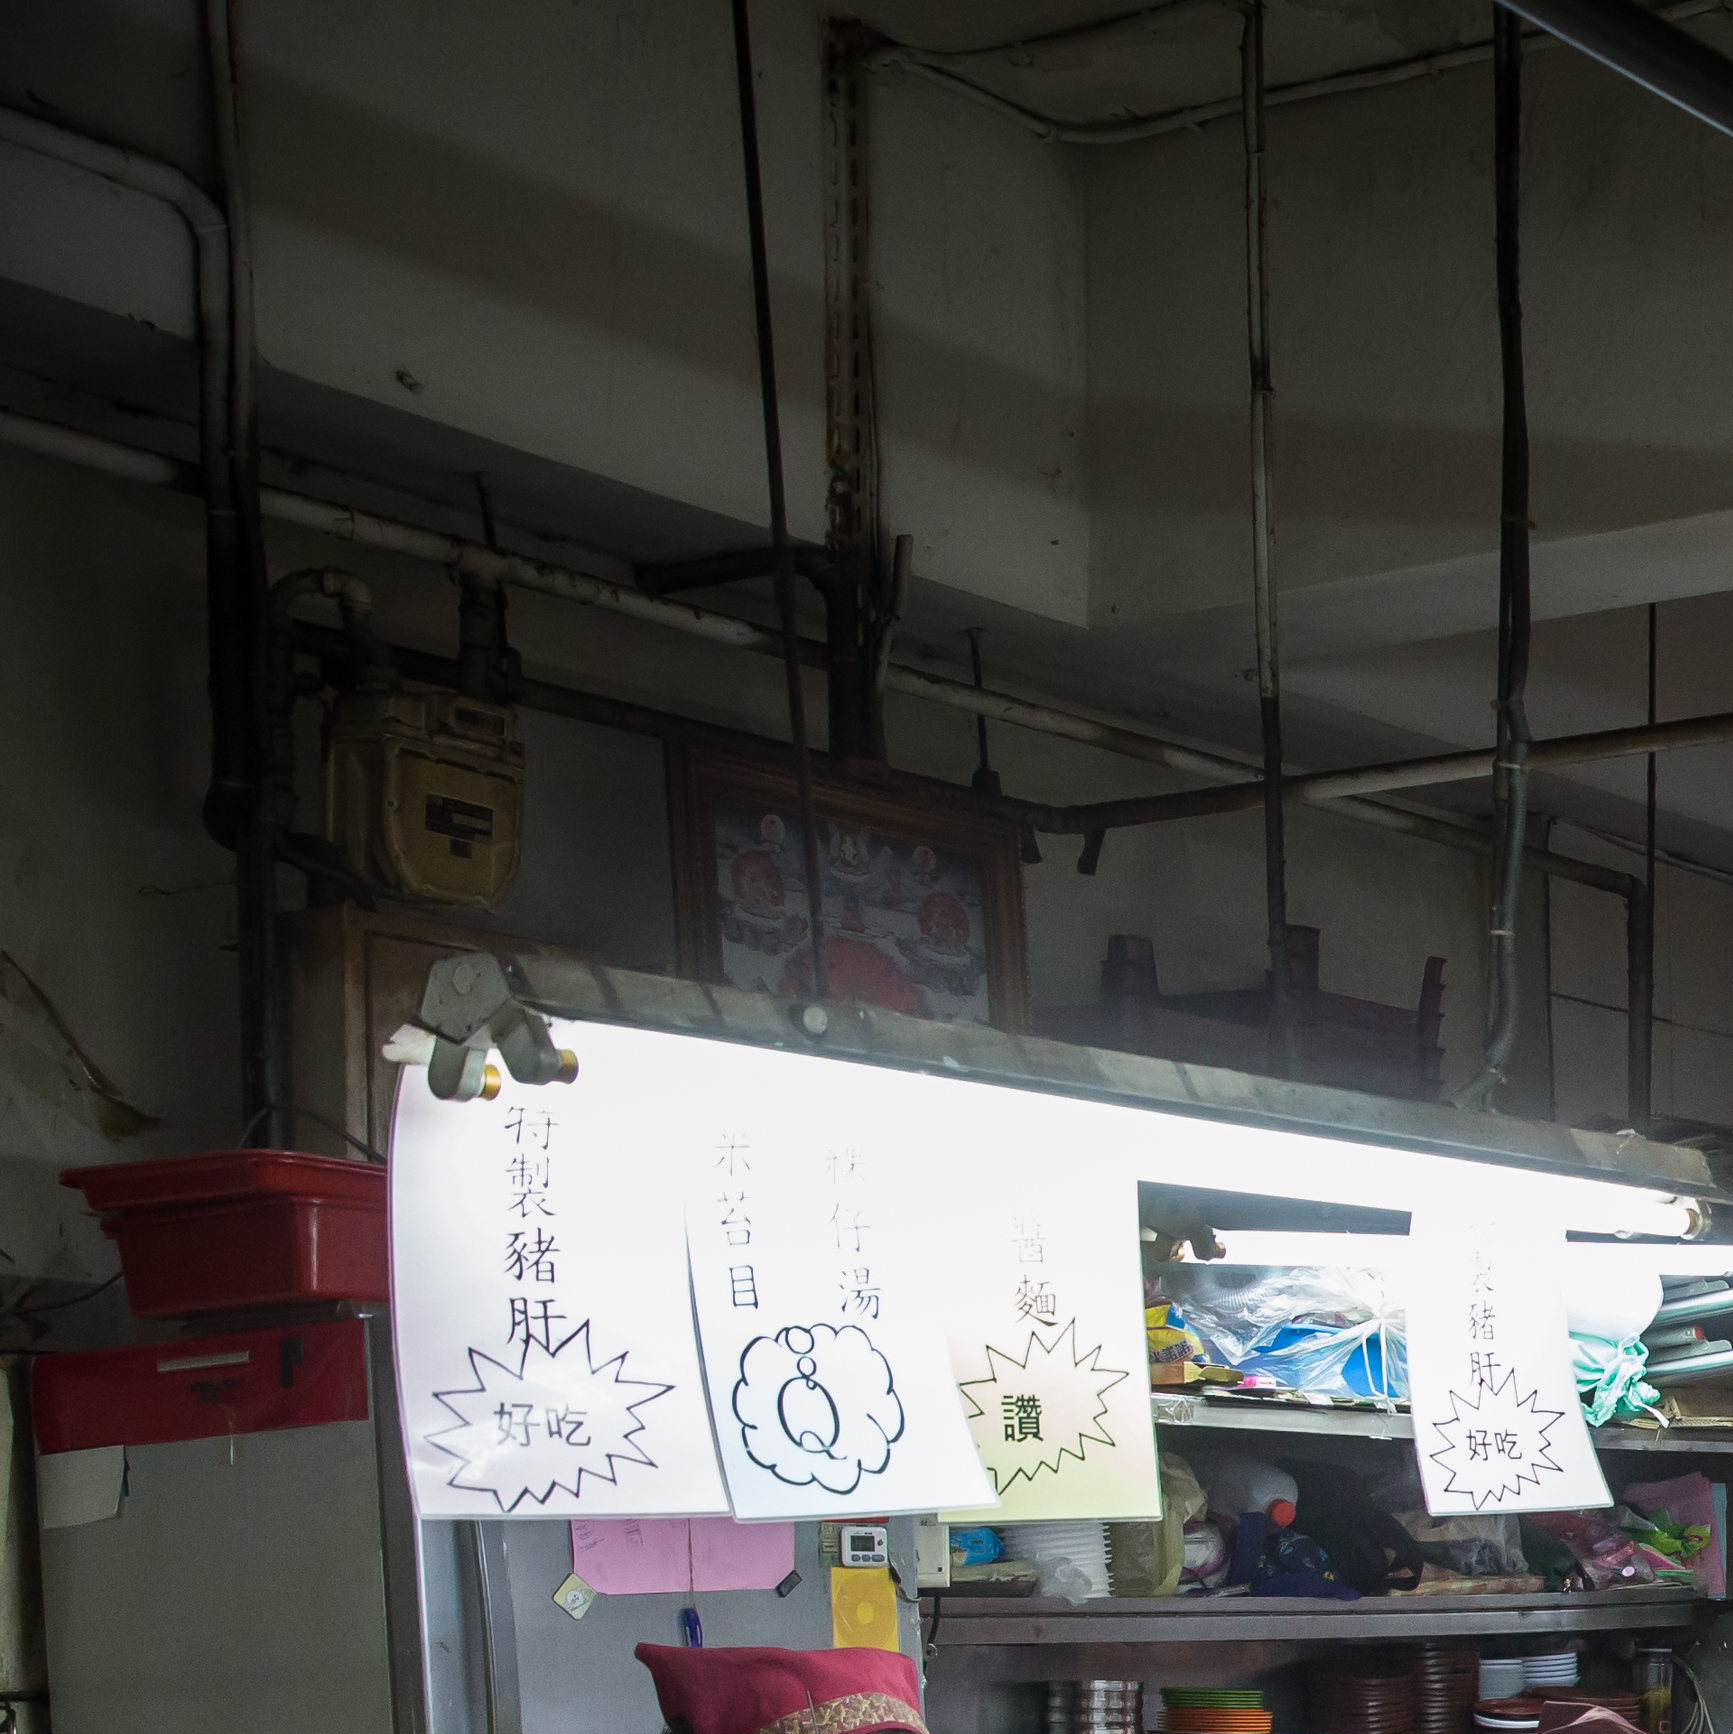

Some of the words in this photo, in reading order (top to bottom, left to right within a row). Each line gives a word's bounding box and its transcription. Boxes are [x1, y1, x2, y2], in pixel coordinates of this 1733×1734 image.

[503, 1105, 567, 1352] 特製豬肝
[714, 1132, 760, 1310] 米苔目
[824, 1146, 882, 1320] 粿仔湯
[1467, 1222, 1502, 1390] 製豬肝
[493, 1400, 592, 1450] 好吃
[1000, 1394, 1045, 1443] 讚
[1466, 1428, 1523, 1462] 好吃
